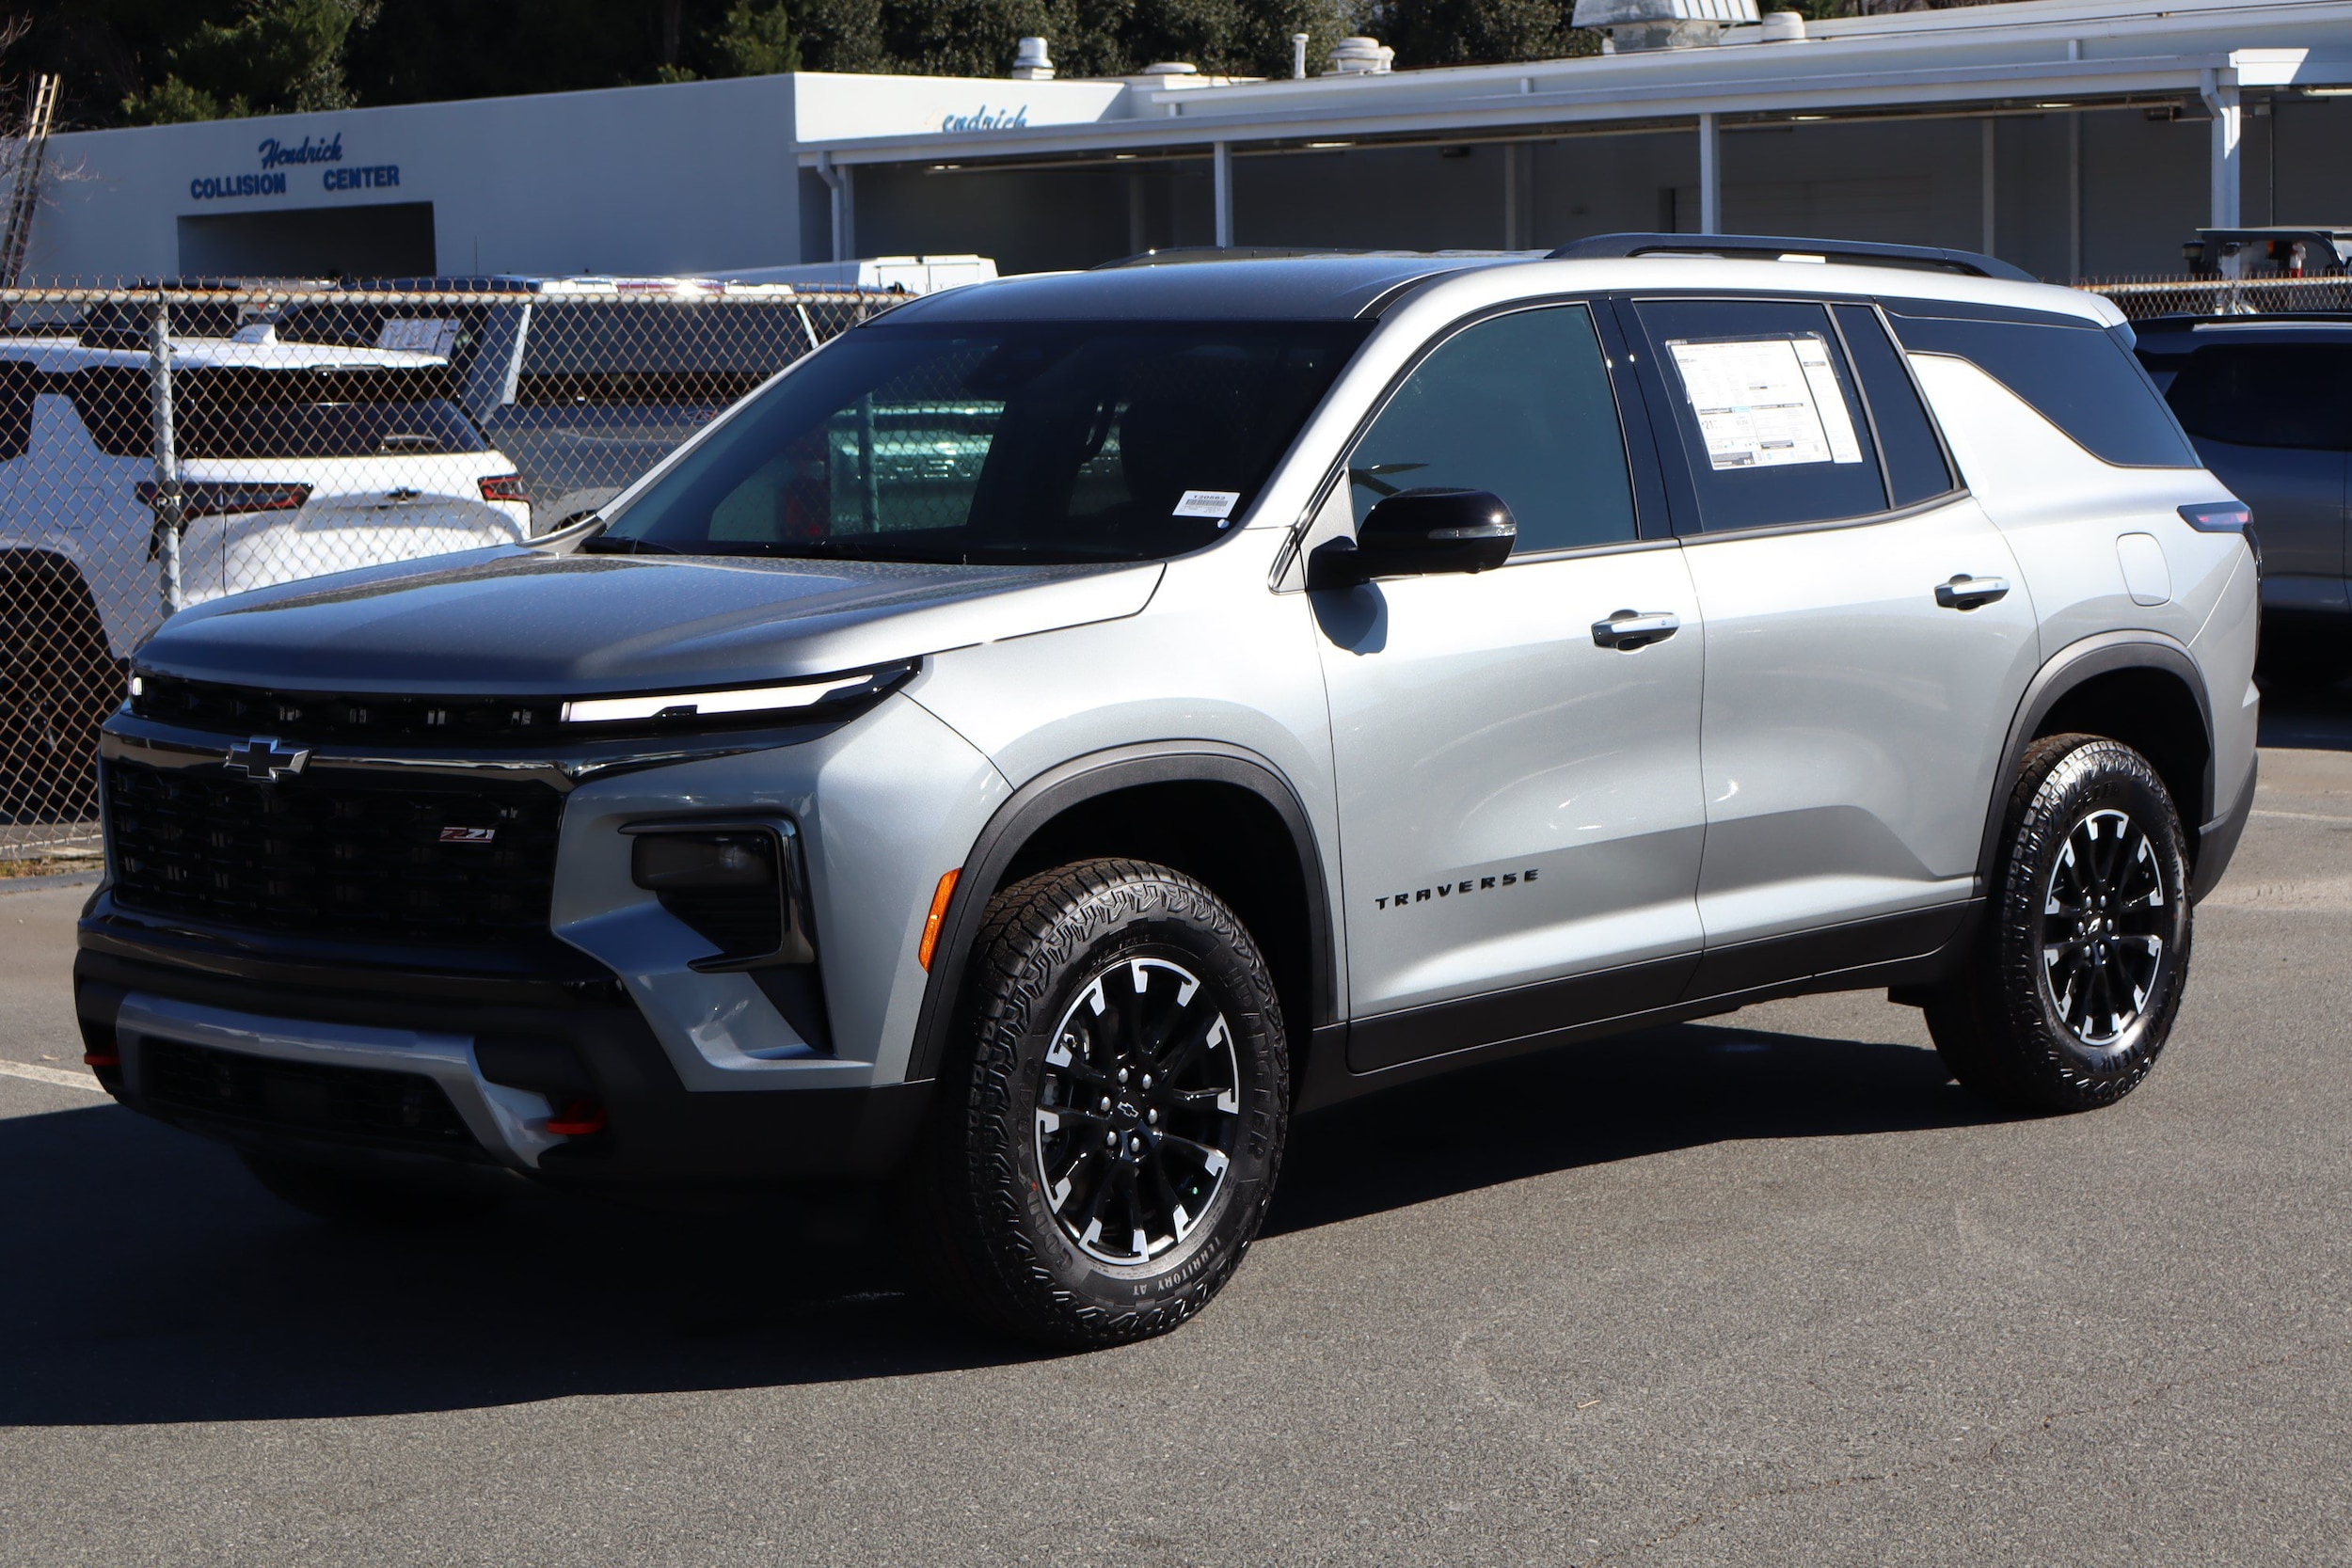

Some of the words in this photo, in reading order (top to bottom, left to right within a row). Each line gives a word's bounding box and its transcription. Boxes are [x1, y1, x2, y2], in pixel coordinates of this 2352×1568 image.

[259, 132, 342, 169] Hendrick
[190, 172, 286, 199] COLLISION
[323, 165, 400, 191] CENTER
[1375, 868, 1539, 911] TRAVERSE
[1157, 1236, 1222, 1292] TERRITORY
[1132, 1283, 1148, 1296] AT
